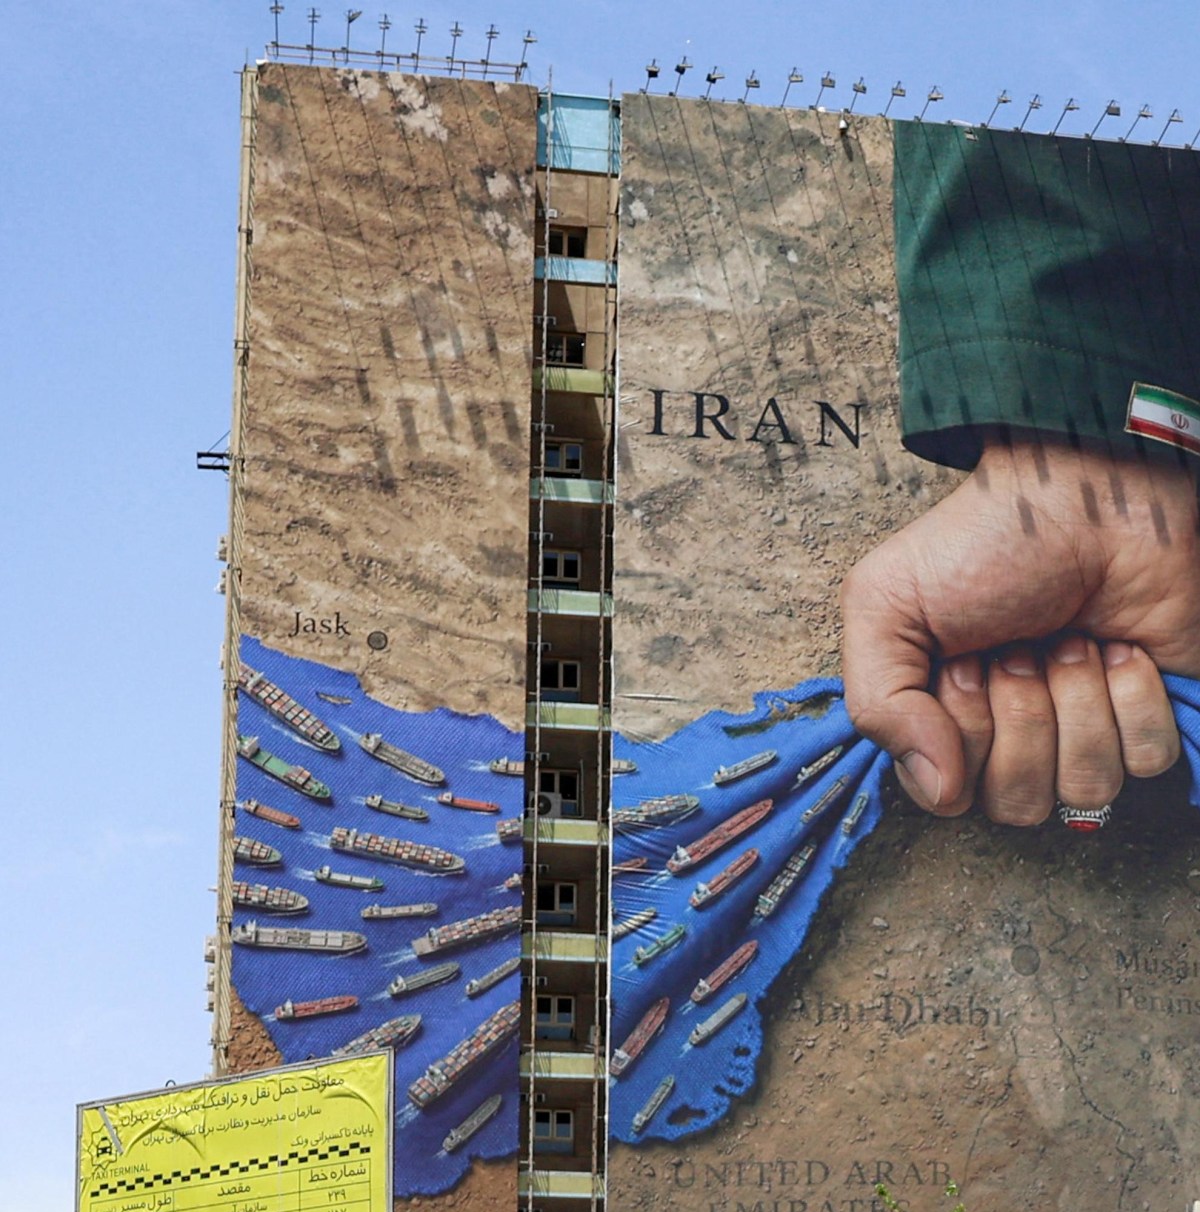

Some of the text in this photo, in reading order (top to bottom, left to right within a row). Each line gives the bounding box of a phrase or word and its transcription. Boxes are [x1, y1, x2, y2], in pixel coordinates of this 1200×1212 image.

[646, 389, 867, 449] IRAN
[288, 611, 351, 638] Jask
[880, 992, 1001, 1028] Dhabi
[273, 1082, 297, 1101] حمل
[302, 1075, 344, 1093] معاونت
[203, 1092, 239, 1110] ترافیک
[241, 1094, 248, 1106] و
[250, 1087, 270, 1105] نقل
[120, 1110, 149, 1127] تهران
[251, 1114, 286, 1127] مدیریت
[288, 1105, 321, 1121] سازمان
[353, 1124, 374, 1138] پایانه
[291, 1137, 308, 1147] ونک
[110, 1164, 150, 1177] TERMINAL
[309, 1163, 366, 1183] شماره خط
[672, 1160, 952, 1189] UNITED ARAB
[217, 1183, 251, 1197] مقصد
[148, 1194, 171, 1211] طول
